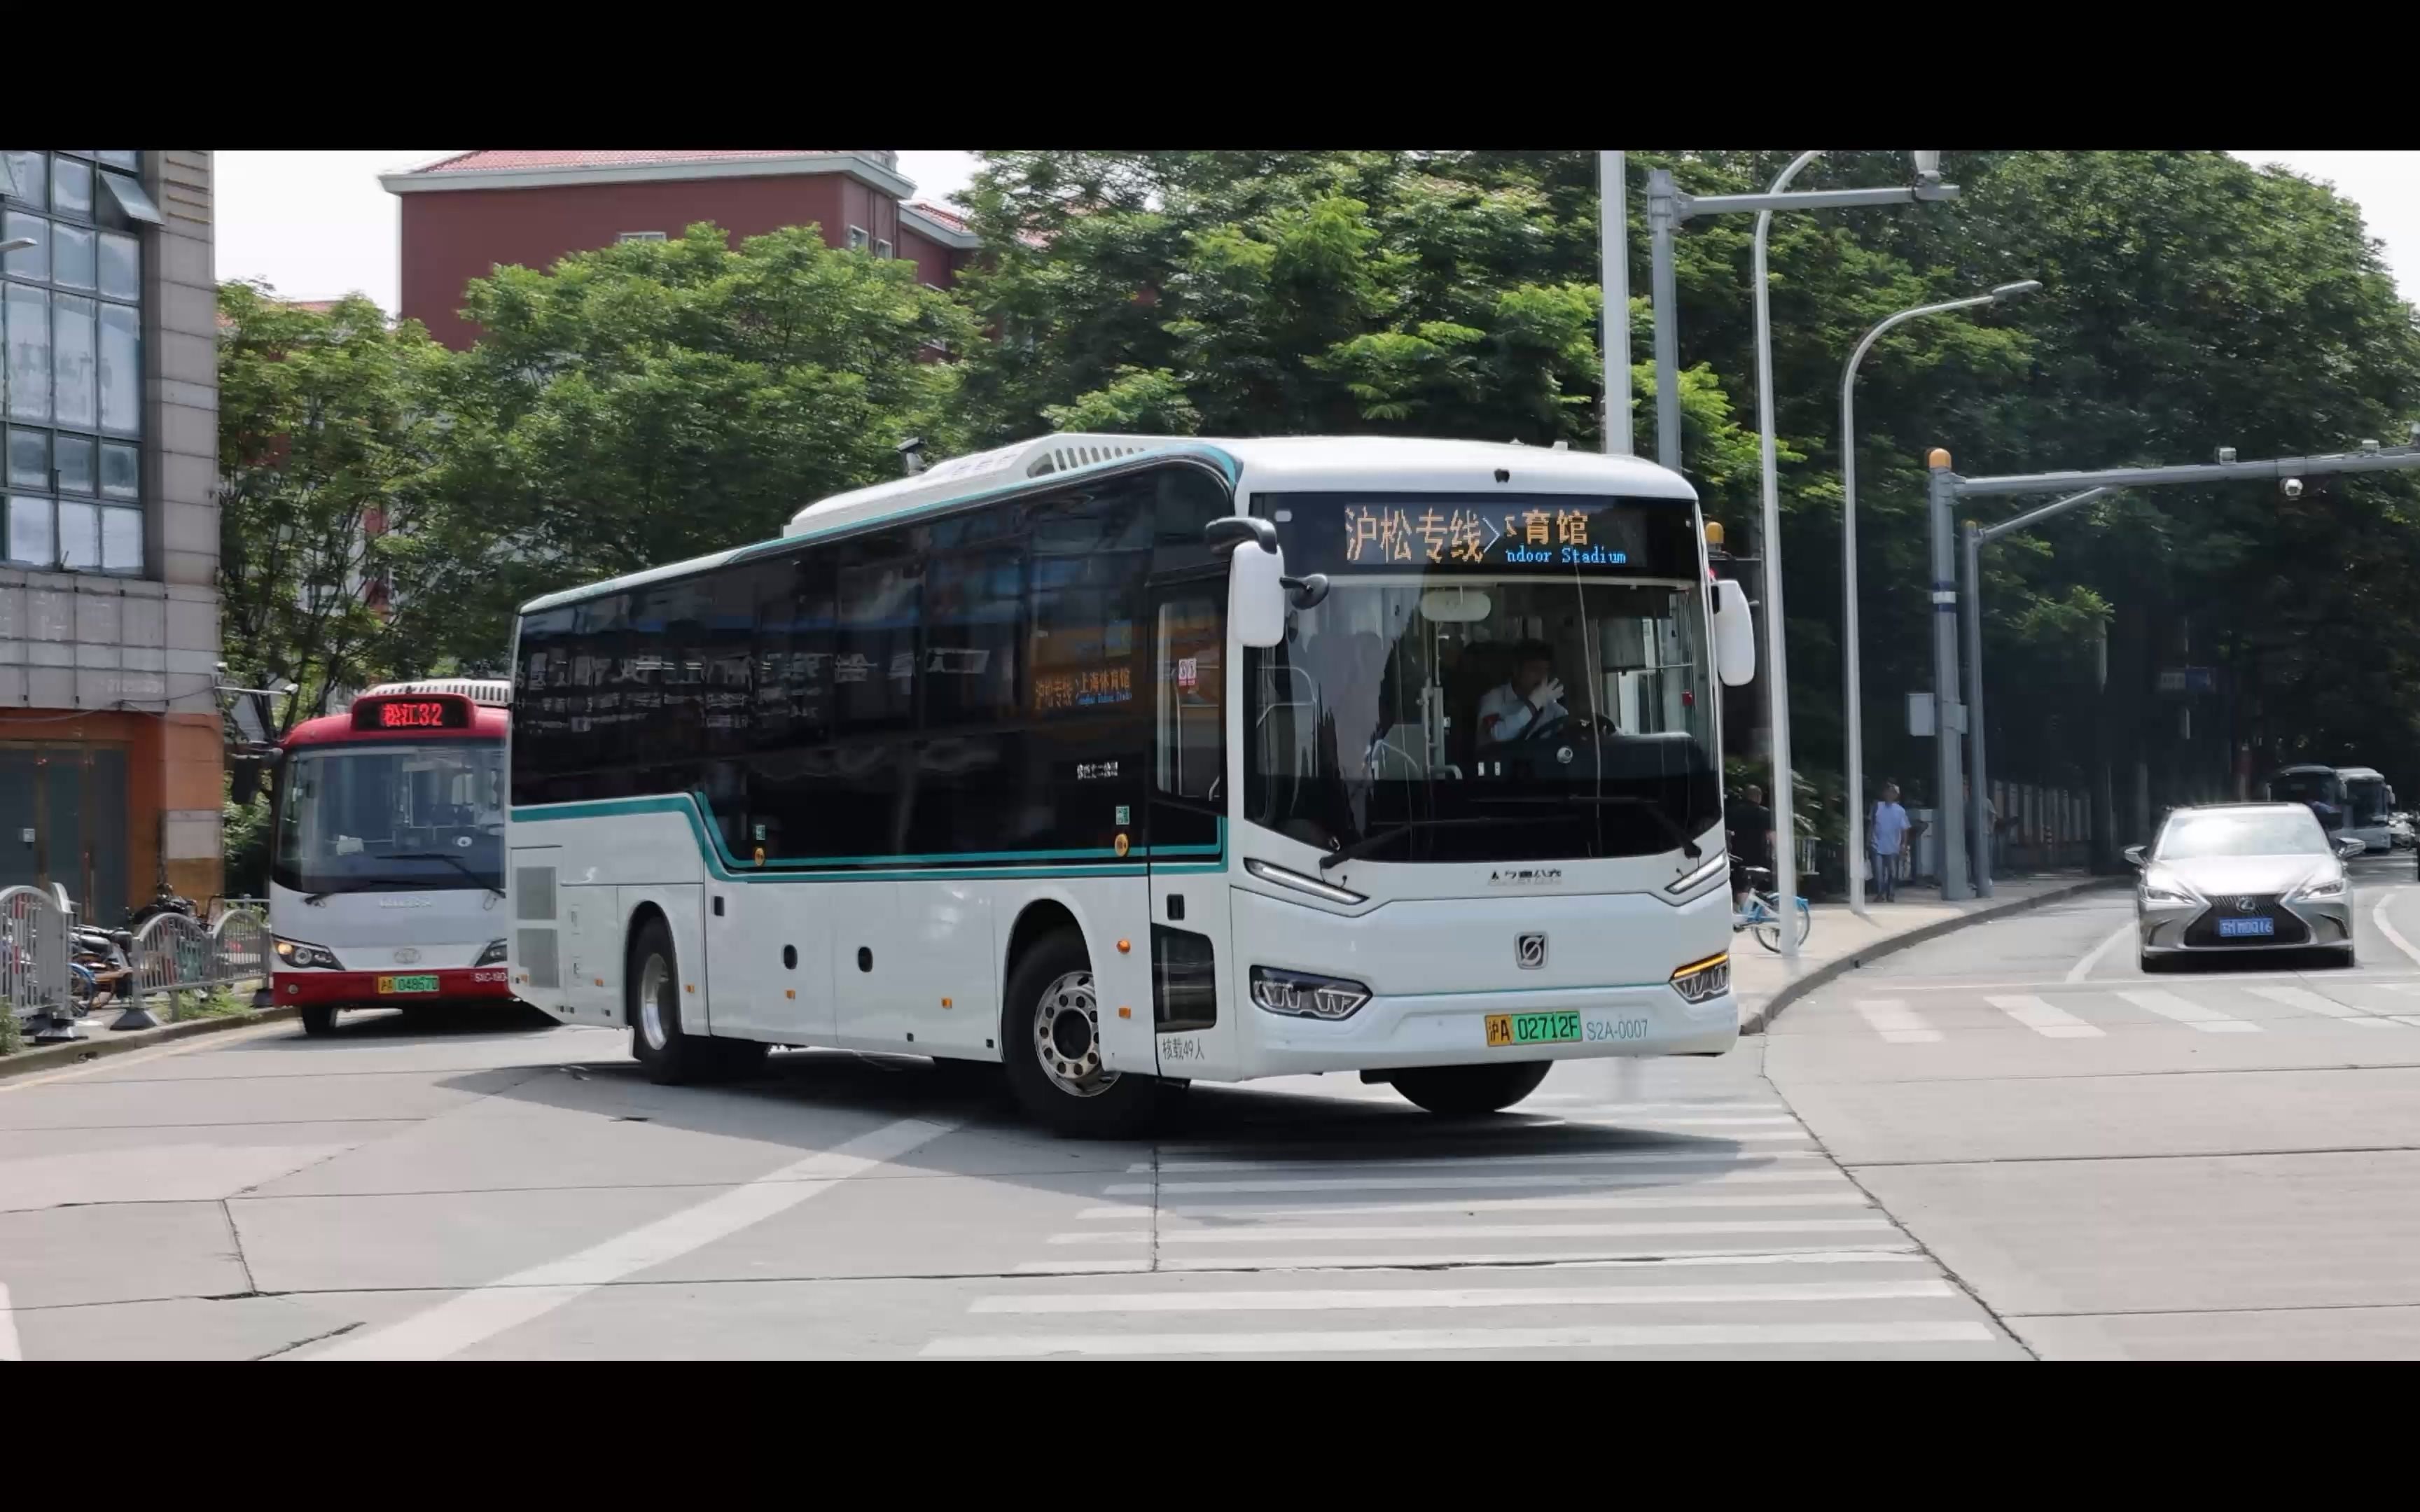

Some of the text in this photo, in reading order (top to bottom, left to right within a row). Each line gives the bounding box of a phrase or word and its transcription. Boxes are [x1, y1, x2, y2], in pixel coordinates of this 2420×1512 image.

[1345, 505, 1589, 563] 沪松专线 育馆
[1562, 544, 1627, 564] Stadium
[1586, 1018, 1648, 1041] S2A-0007
